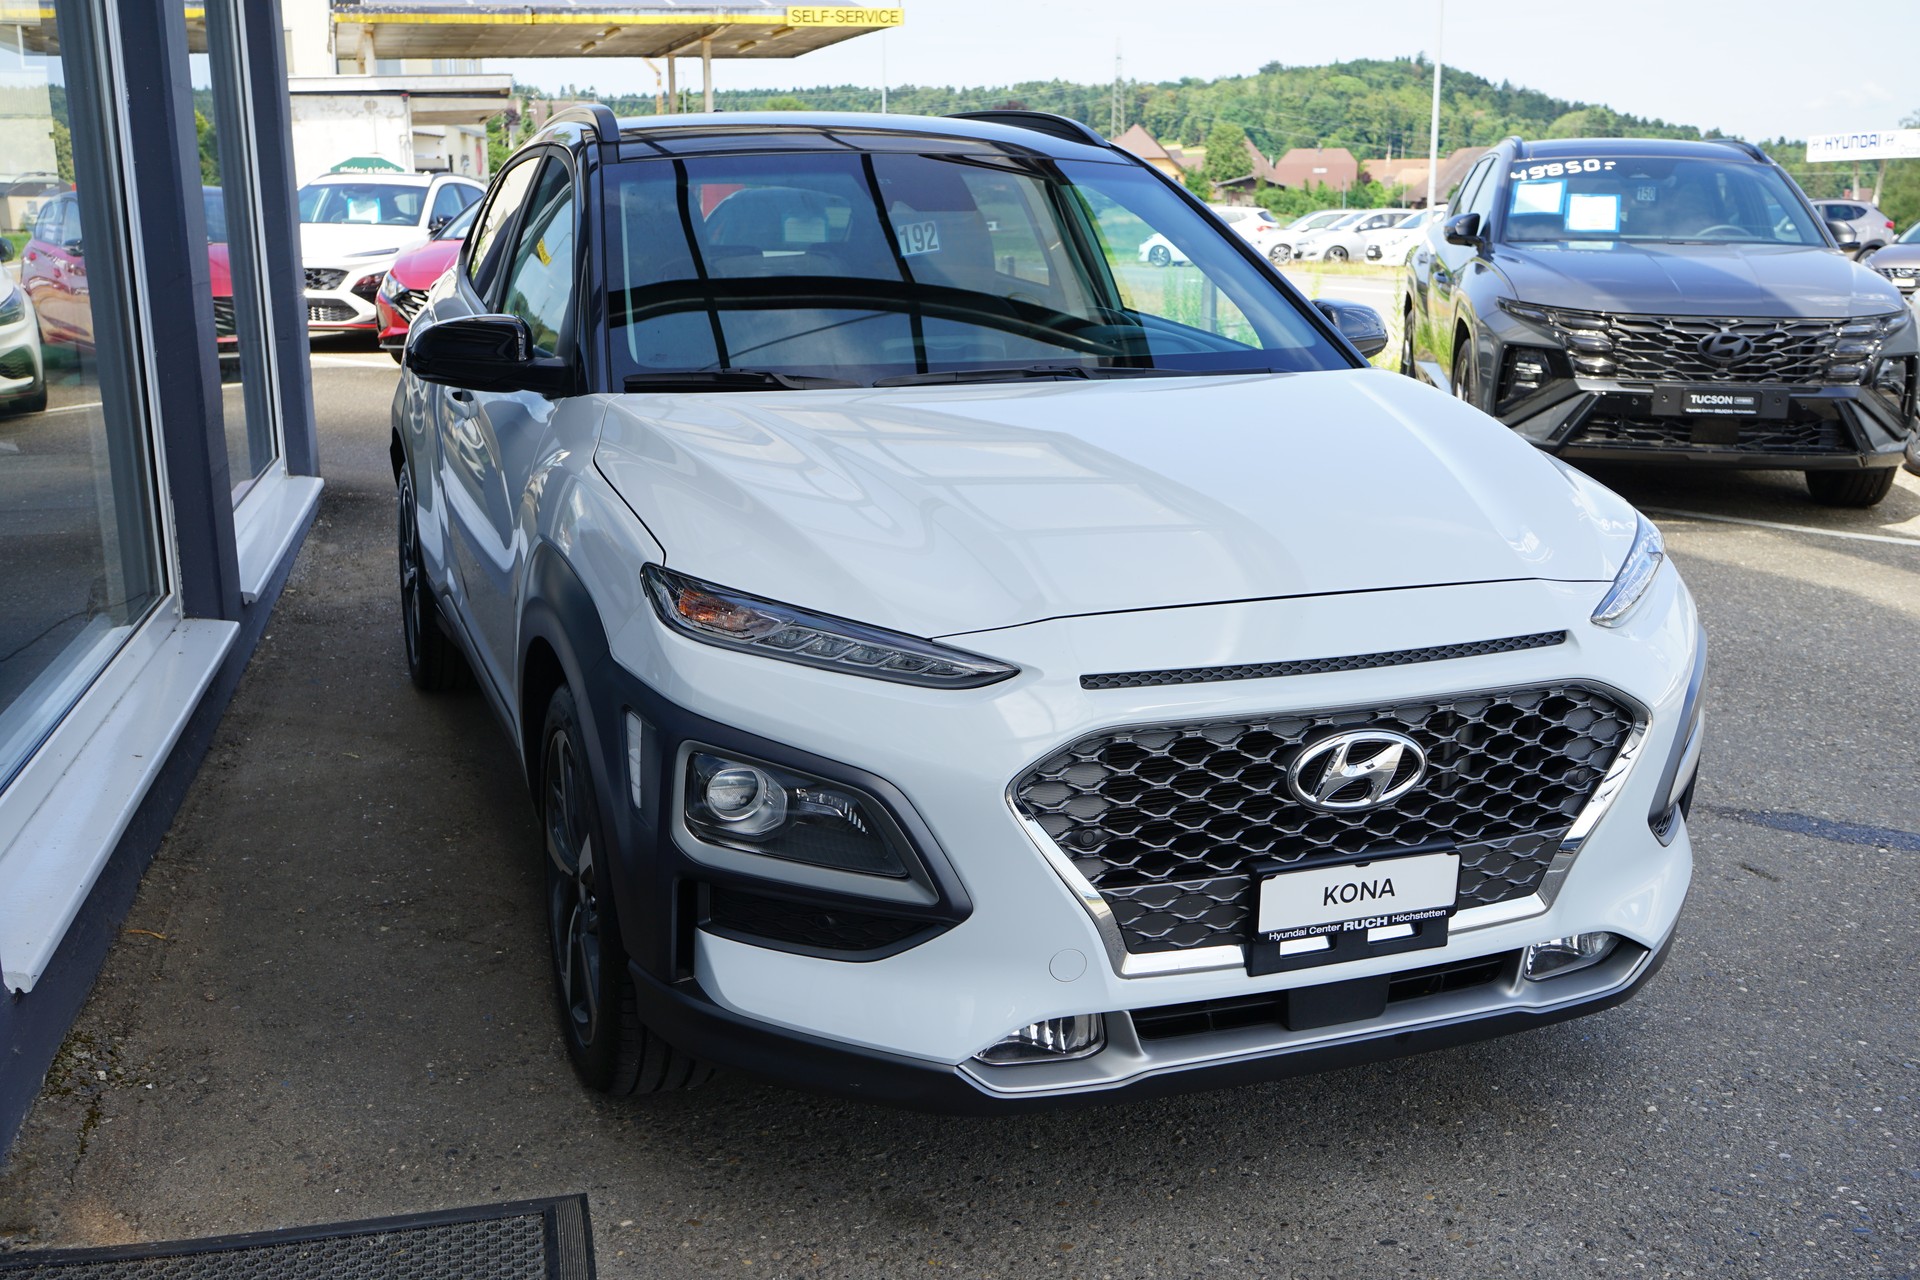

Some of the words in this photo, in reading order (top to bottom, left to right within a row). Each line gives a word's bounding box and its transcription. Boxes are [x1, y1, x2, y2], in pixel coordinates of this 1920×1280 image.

[791, 9, 900, 24] SELF-SERVICE
[1824, 133, 1881, 151] HYUNDAI
[899, 222, 939, 254] 192
[1690, 394, 1733, 405] TUCSON
[1322, 878, 1396, 907] KONA
[1268, 928, 1307, 942] Hyundai
[1309, 923, 1342, 935] Center
[1343, 916, 1389, 932] RUCH
[1391, 908, 1447, 923] Höchstetten
